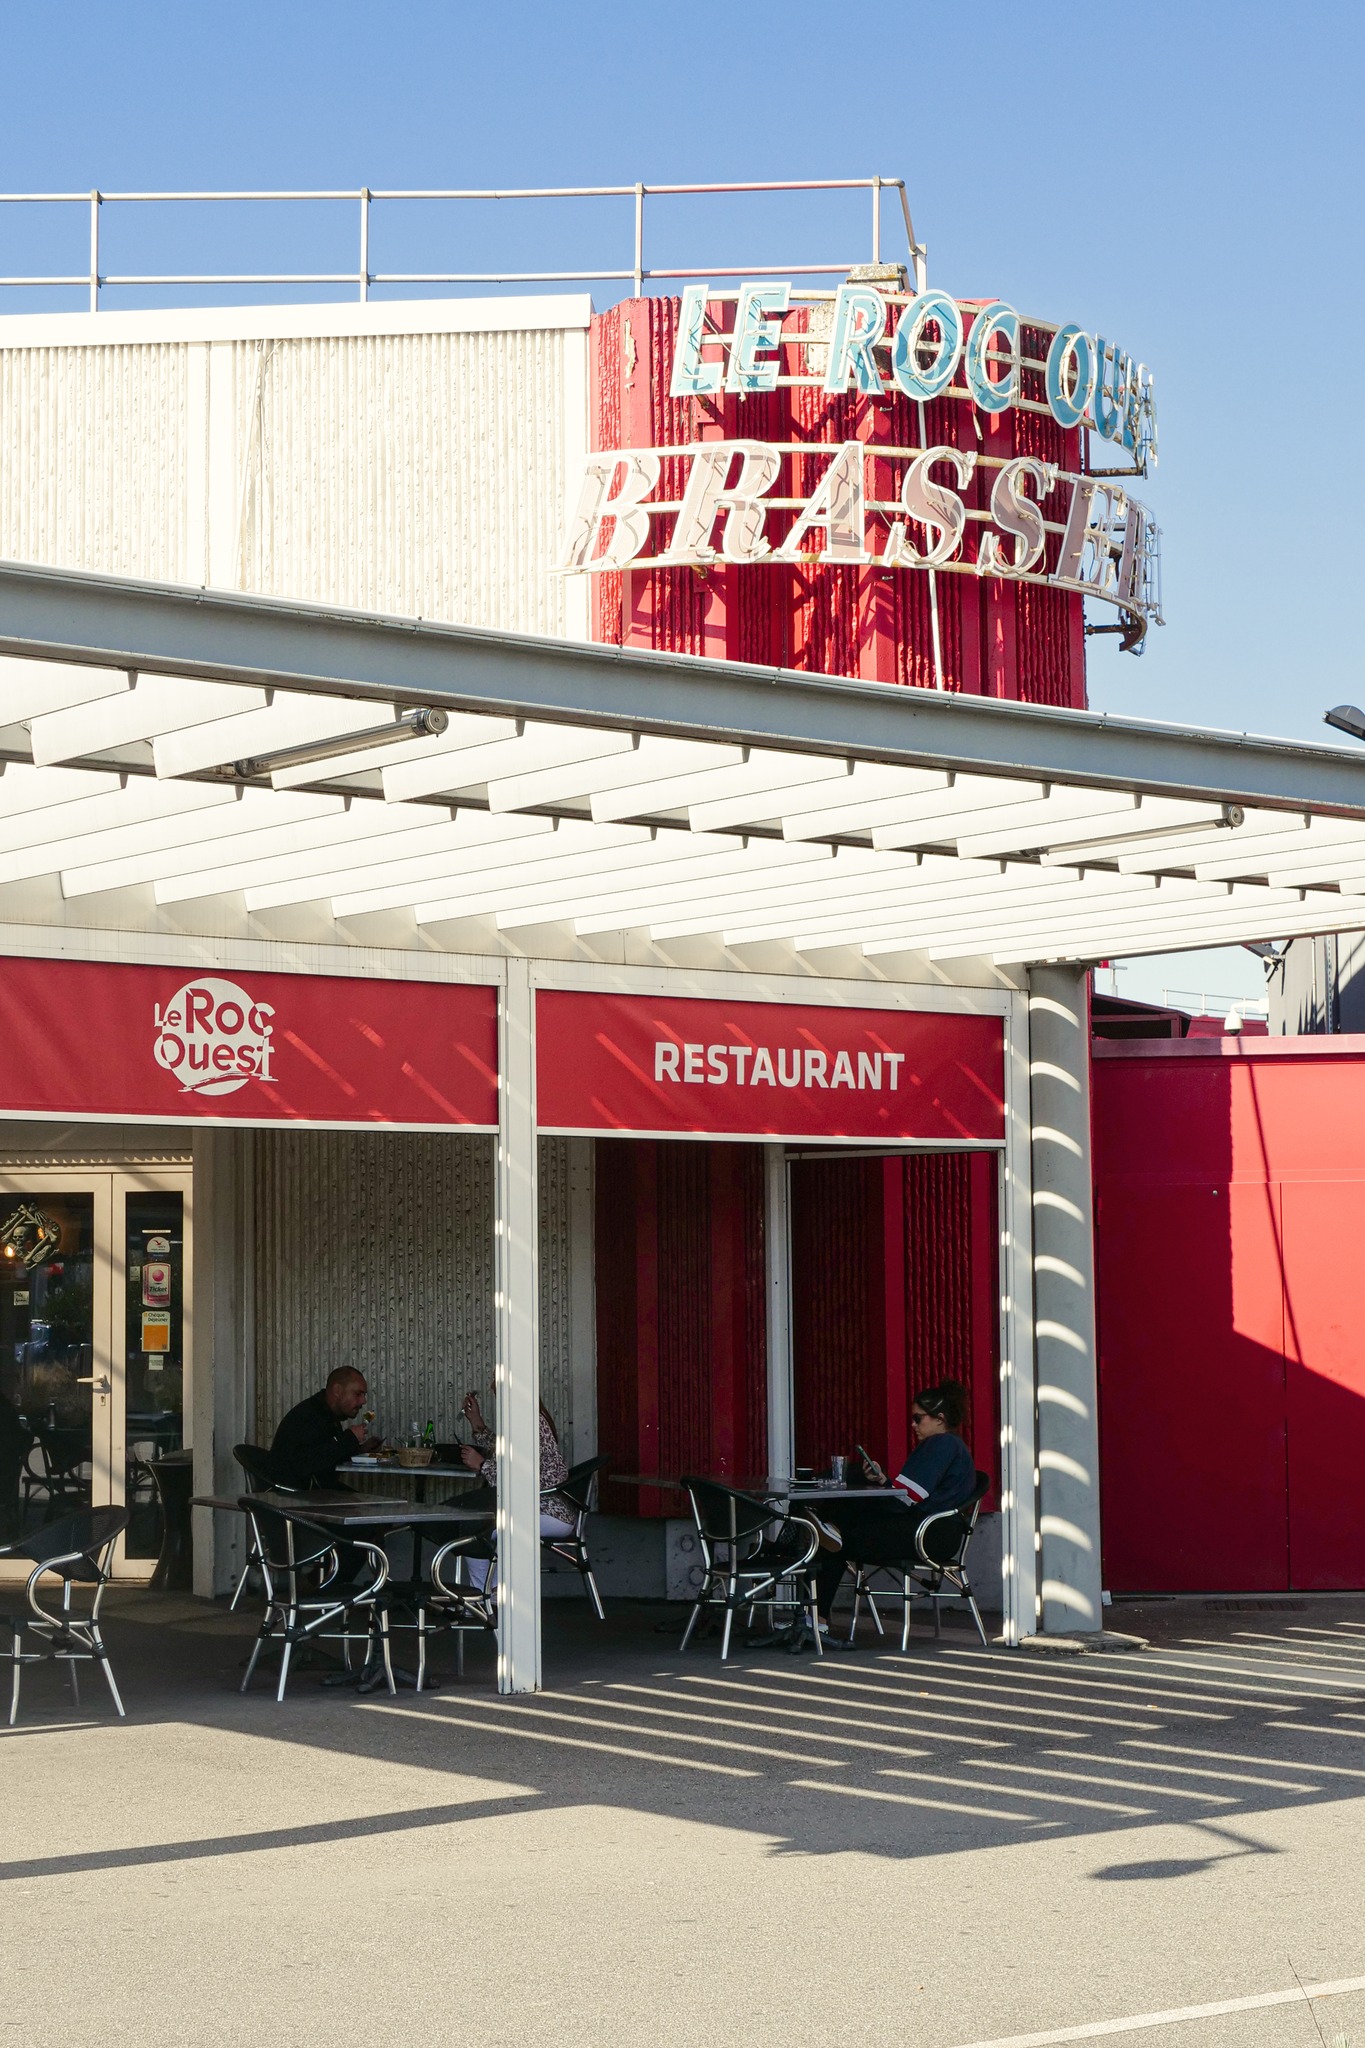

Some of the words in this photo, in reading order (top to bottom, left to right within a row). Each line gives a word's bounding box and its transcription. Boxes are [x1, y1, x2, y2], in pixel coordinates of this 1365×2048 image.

[669, 281, 792, 398] LE
[823, 284, 1021, 414] ROC
[154, 1002, 182, 1027] Le
[654, 1041, 905, 1091] RESTAURANT
